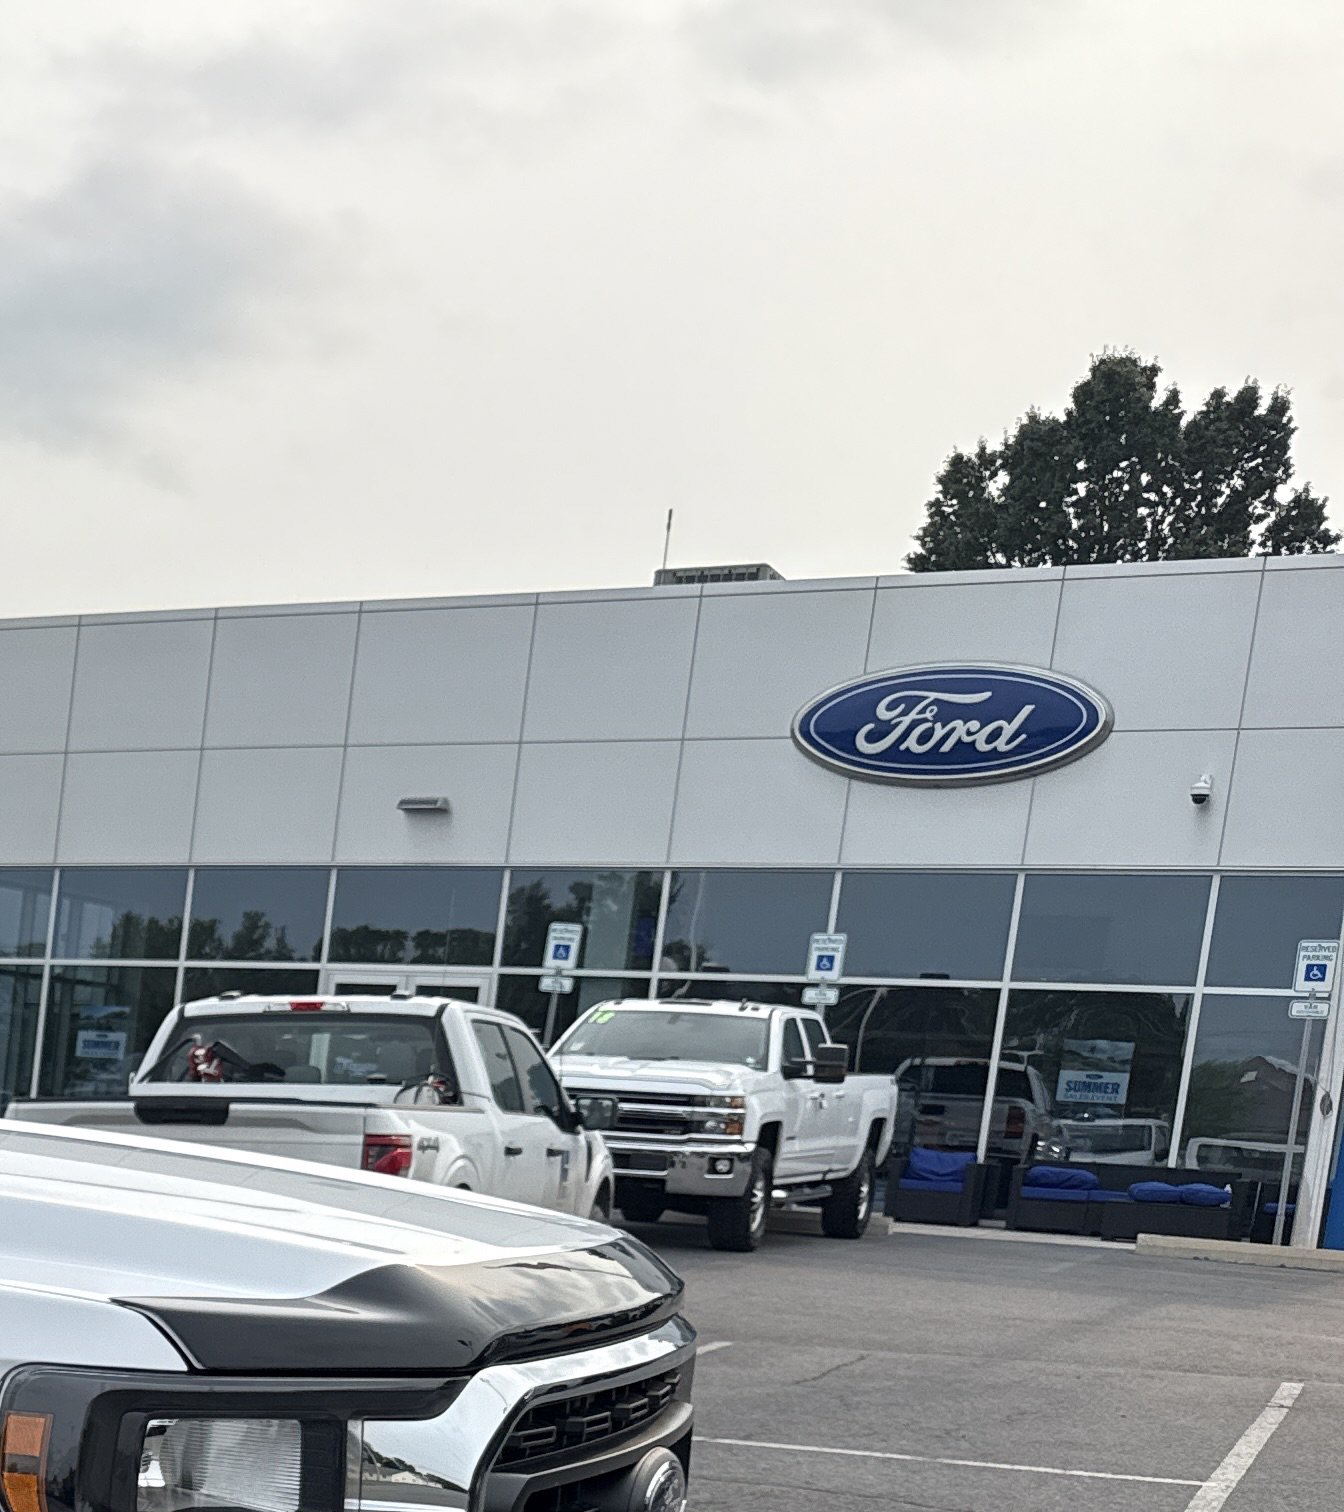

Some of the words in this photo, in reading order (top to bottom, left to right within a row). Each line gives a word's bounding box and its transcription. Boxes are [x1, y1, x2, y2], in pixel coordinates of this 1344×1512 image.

[855, 690, 1036, 754] Ford
[1301, 945, 1337, 953] RESERVED
[1302, 954, 1334, 962] PARKING
[1065, 1080, 1121, 1094] SUMMER
